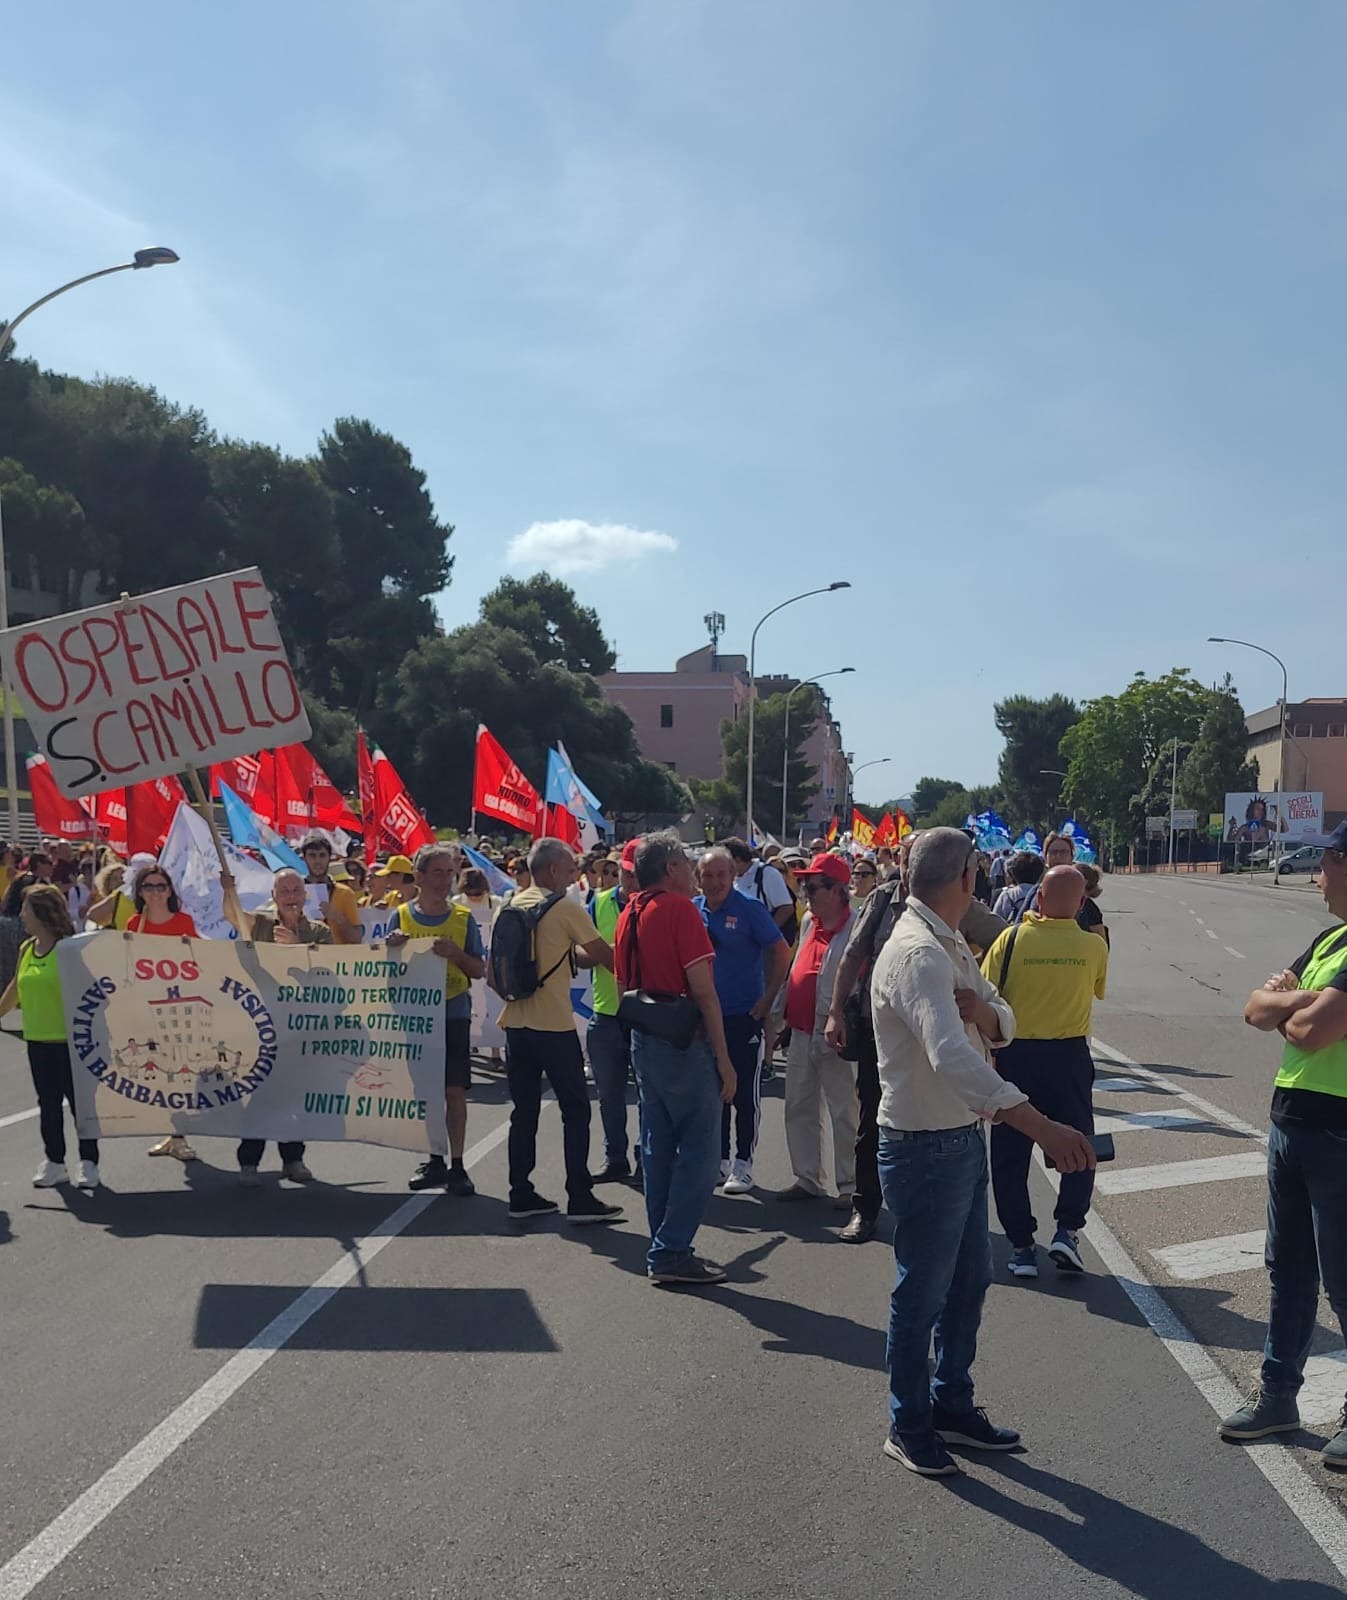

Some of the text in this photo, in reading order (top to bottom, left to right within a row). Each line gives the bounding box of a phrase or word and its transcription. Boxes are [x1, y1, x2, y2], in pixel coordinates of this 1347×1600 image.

[15, 581, 281, 712] OSPEDALE
[386, 804, 414, 840] SPI
[135, 958, 199, 981] SOS
[336, 961, 349, 977] IL
[353, 961, 408, 979] NOSTRO
[277, 985, 442, 1007] SPLENDIDO TERRITORIO
[288, 1013, 434, 1035] LOTTA PER OTTENERE
[73, 976, 278, 1110] SANITÀ BARBAGIA MANDROLISAI
[301, 1039, 423, 1061] I PROPRI DIRITTI!
[304, 1092, 427, 1121] UNITI SI VINCE
